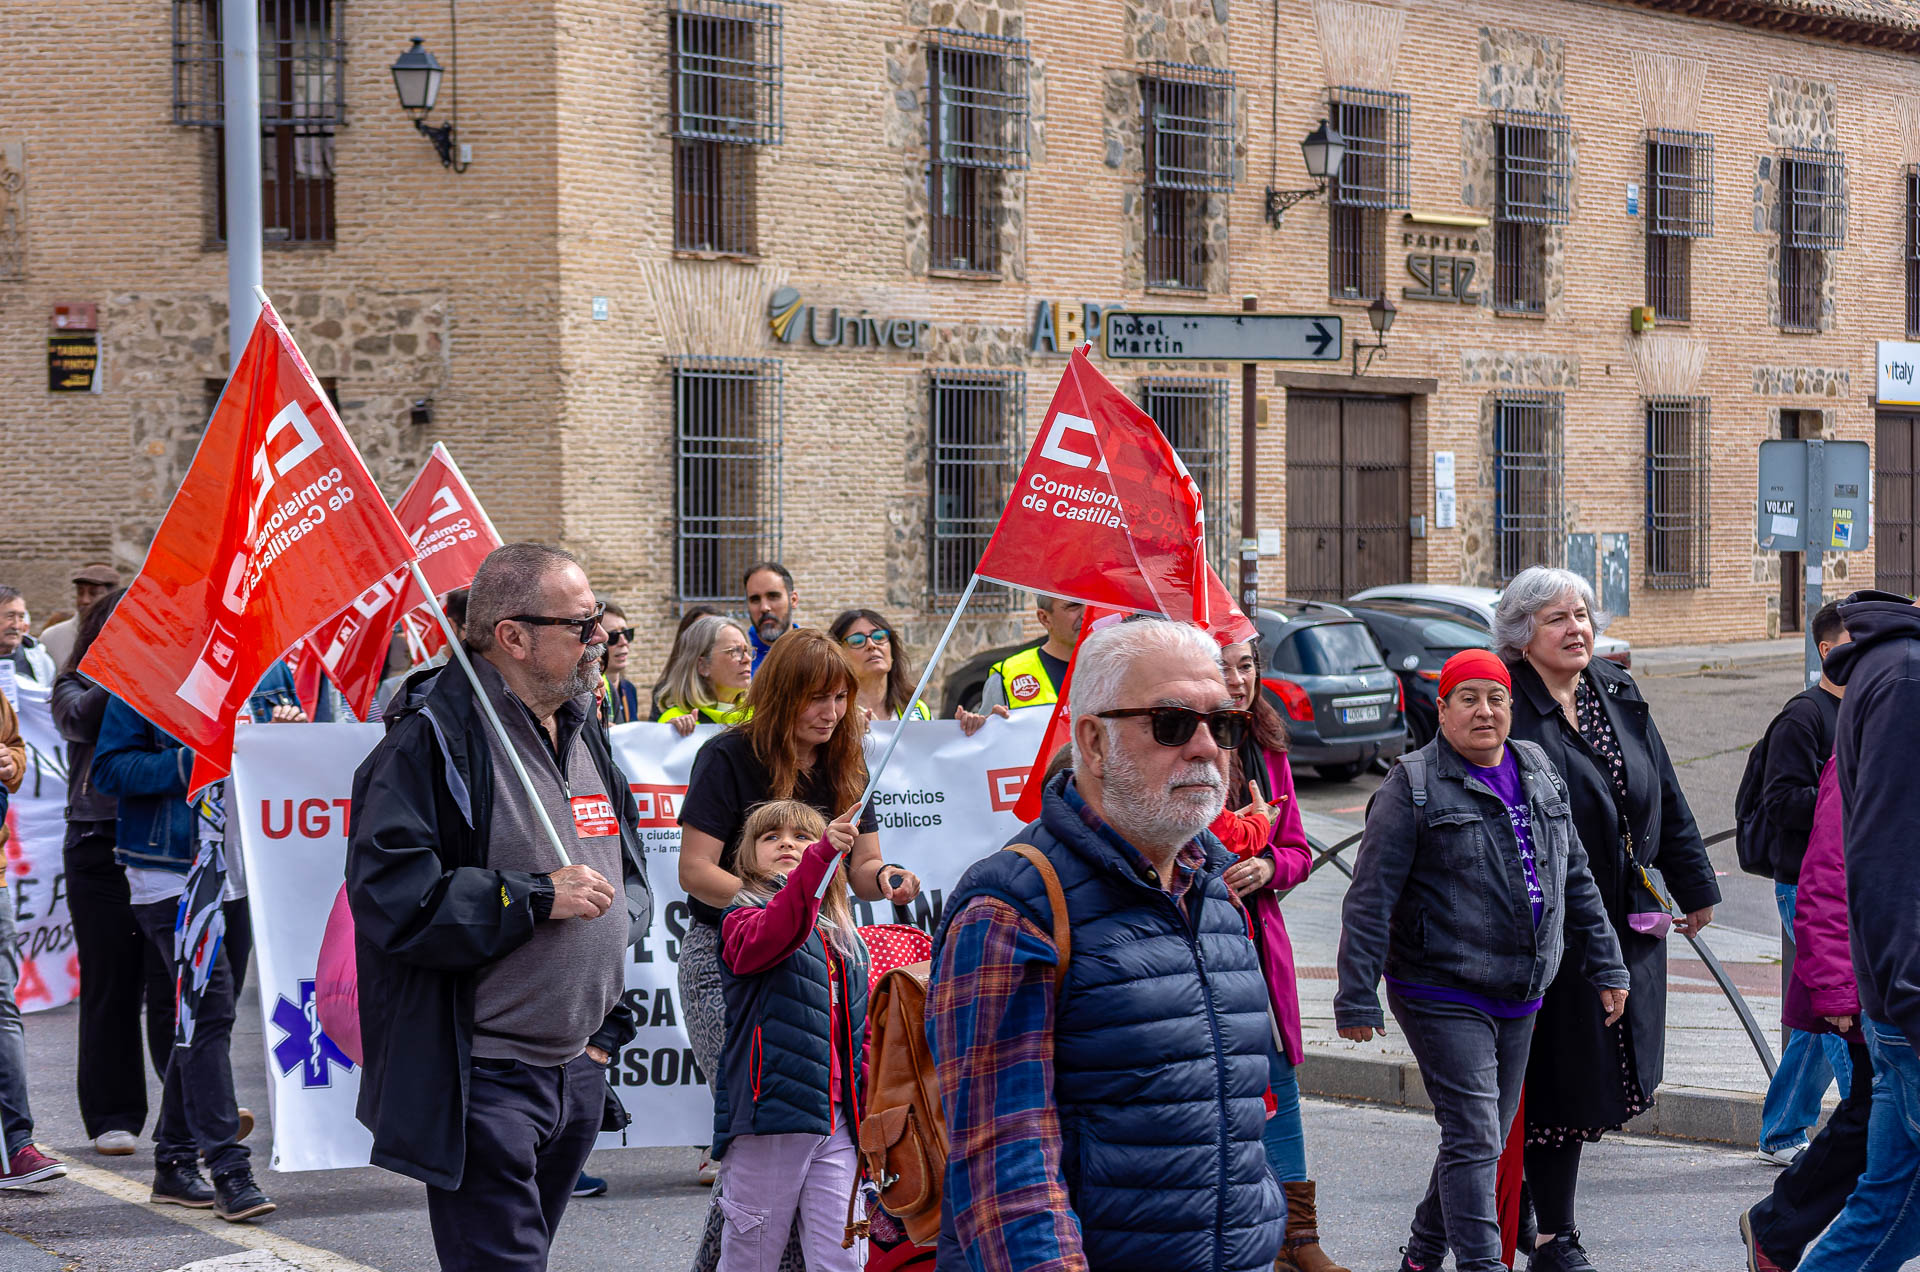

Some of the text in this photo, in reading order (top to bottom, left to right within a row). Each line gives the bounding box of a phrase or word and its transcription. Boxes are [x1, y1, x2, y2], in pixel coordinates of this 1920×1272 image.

[1402, 254, 1481, 304] SER
[810, 307, 930, 347] Univer
[1113, 320, 1164, 335] hotel
[1885, 360, 1914, 385] vitaly
[1021, 493, 1048, 512] de
[872, 789, 945, 805] Servicios
[261, 798, 352, 839] UGT
[875, 812, 942, 828] Públicos
[646, 829, 681, 841] ciudad
